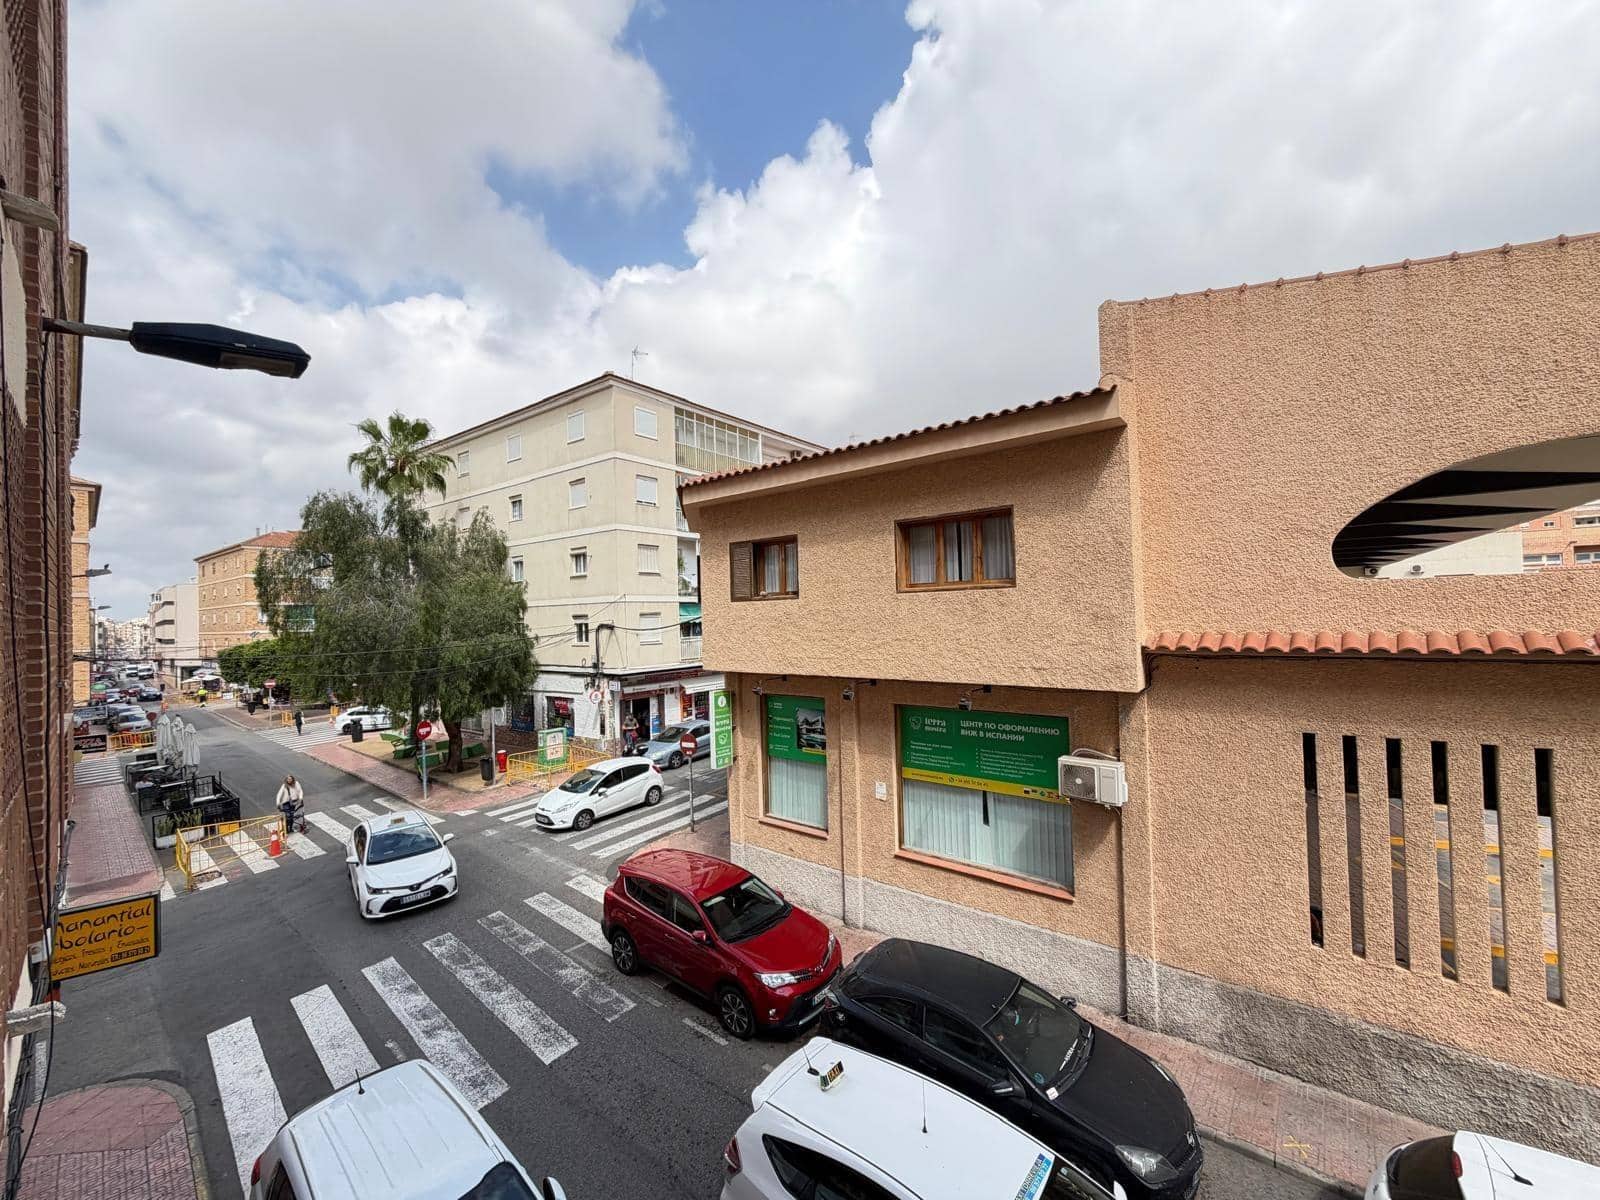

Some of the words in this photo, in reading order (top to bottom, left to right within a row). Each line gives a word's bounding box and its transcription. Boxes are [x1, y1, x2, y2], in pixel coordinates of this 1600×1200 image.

[960, 720, 983, 728] ЦЕНТР
[984, 722, 996, 730] ПО
[997, 723, 1060, 736] ОФОРМЛЕНИЮ
[985, 731, 1025, 742] ИСПАНИИ
